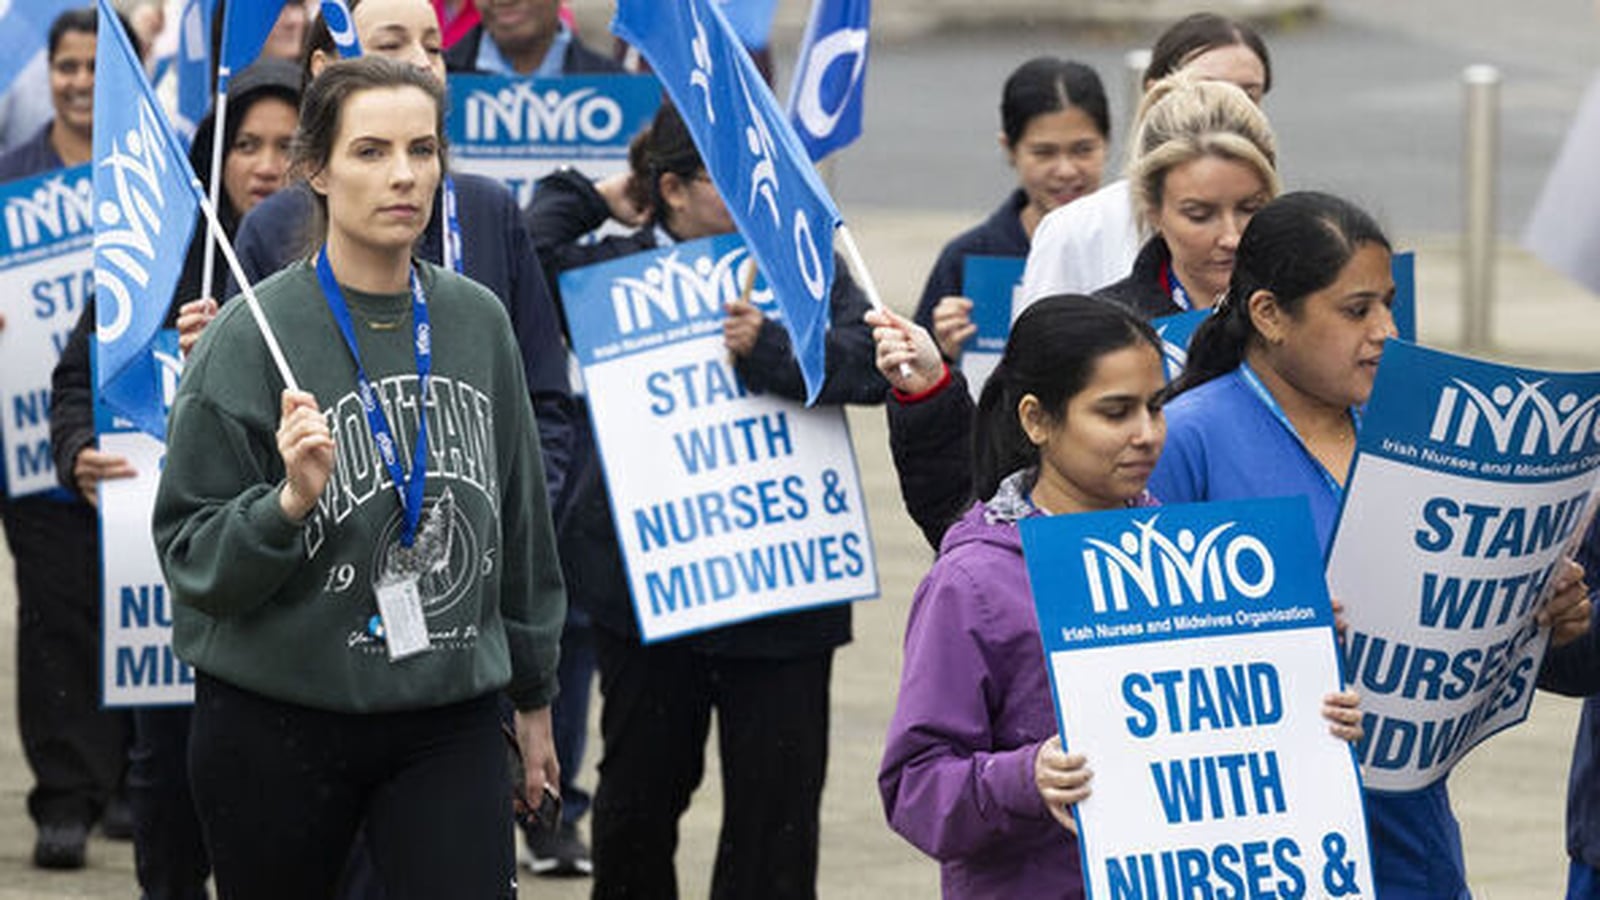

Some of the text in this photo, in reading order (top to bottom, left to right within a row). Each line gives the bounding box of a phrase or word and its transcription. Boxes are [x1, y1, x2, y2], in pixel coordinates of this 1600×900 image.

[466, 79, 623, 141] INMO
[4, 175, 94, 249] INM
[646, 360, 748, 416] STA
[1429, 376, 1600, 456] INM
[674, 411, 793, 475] WITH
[1382, 438, 1418, 458] Irish
[1421, 447, 1477, 471] Nurses
[1480, 462, 1512, 476] and
[634, 468, 848, 552] NURSES &
[324, 563, 355, 592] 19
[645, 532, 864, 616] MIDWIVES
[1082, 513, 1275, 613] INMO
[1062, 604, 1316, 642] Irish Nurses and Midwives Organisation
[1121, 661, 1284, 739] STAND
[1150, 750, 1287, 825] WITH
[1105, 831, 1360, 900] NURSES &
